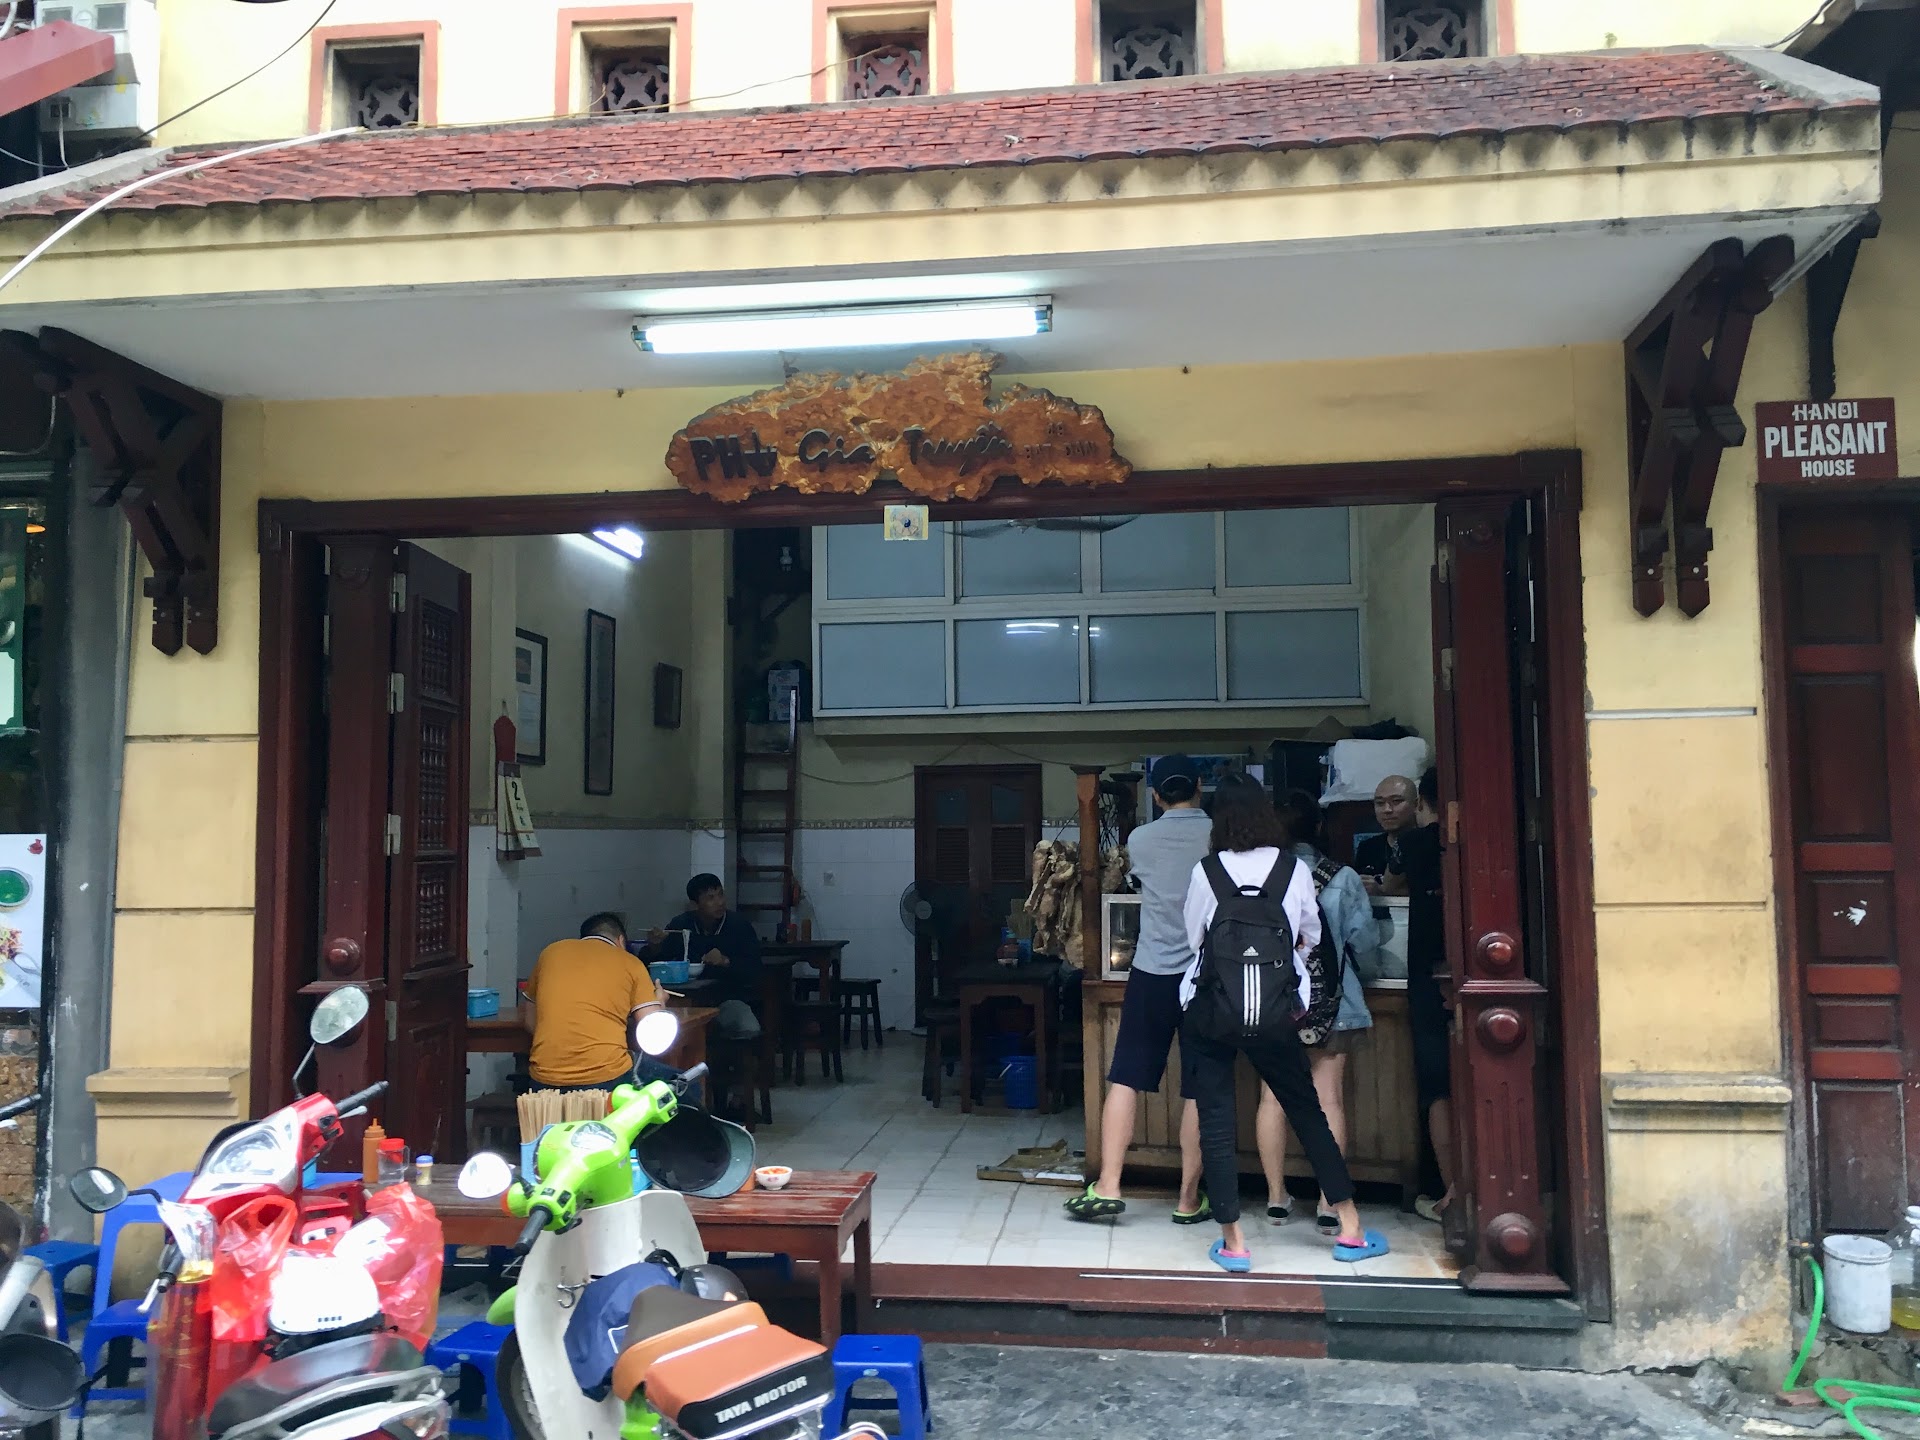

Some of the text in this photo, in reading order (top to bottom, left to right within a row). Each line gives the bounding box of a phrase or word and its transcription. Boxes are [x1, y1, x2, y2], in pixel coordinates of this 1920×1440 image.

[1792, 402, 1858, 421] HANOI
[798, 427, 876, 473] Gia
[1764, 421, 1888, 459] PLEASANT
[1801, 459, 1856, 478] HOUSE
[715, 1375, 808, 1424] TAYA MOTOR
